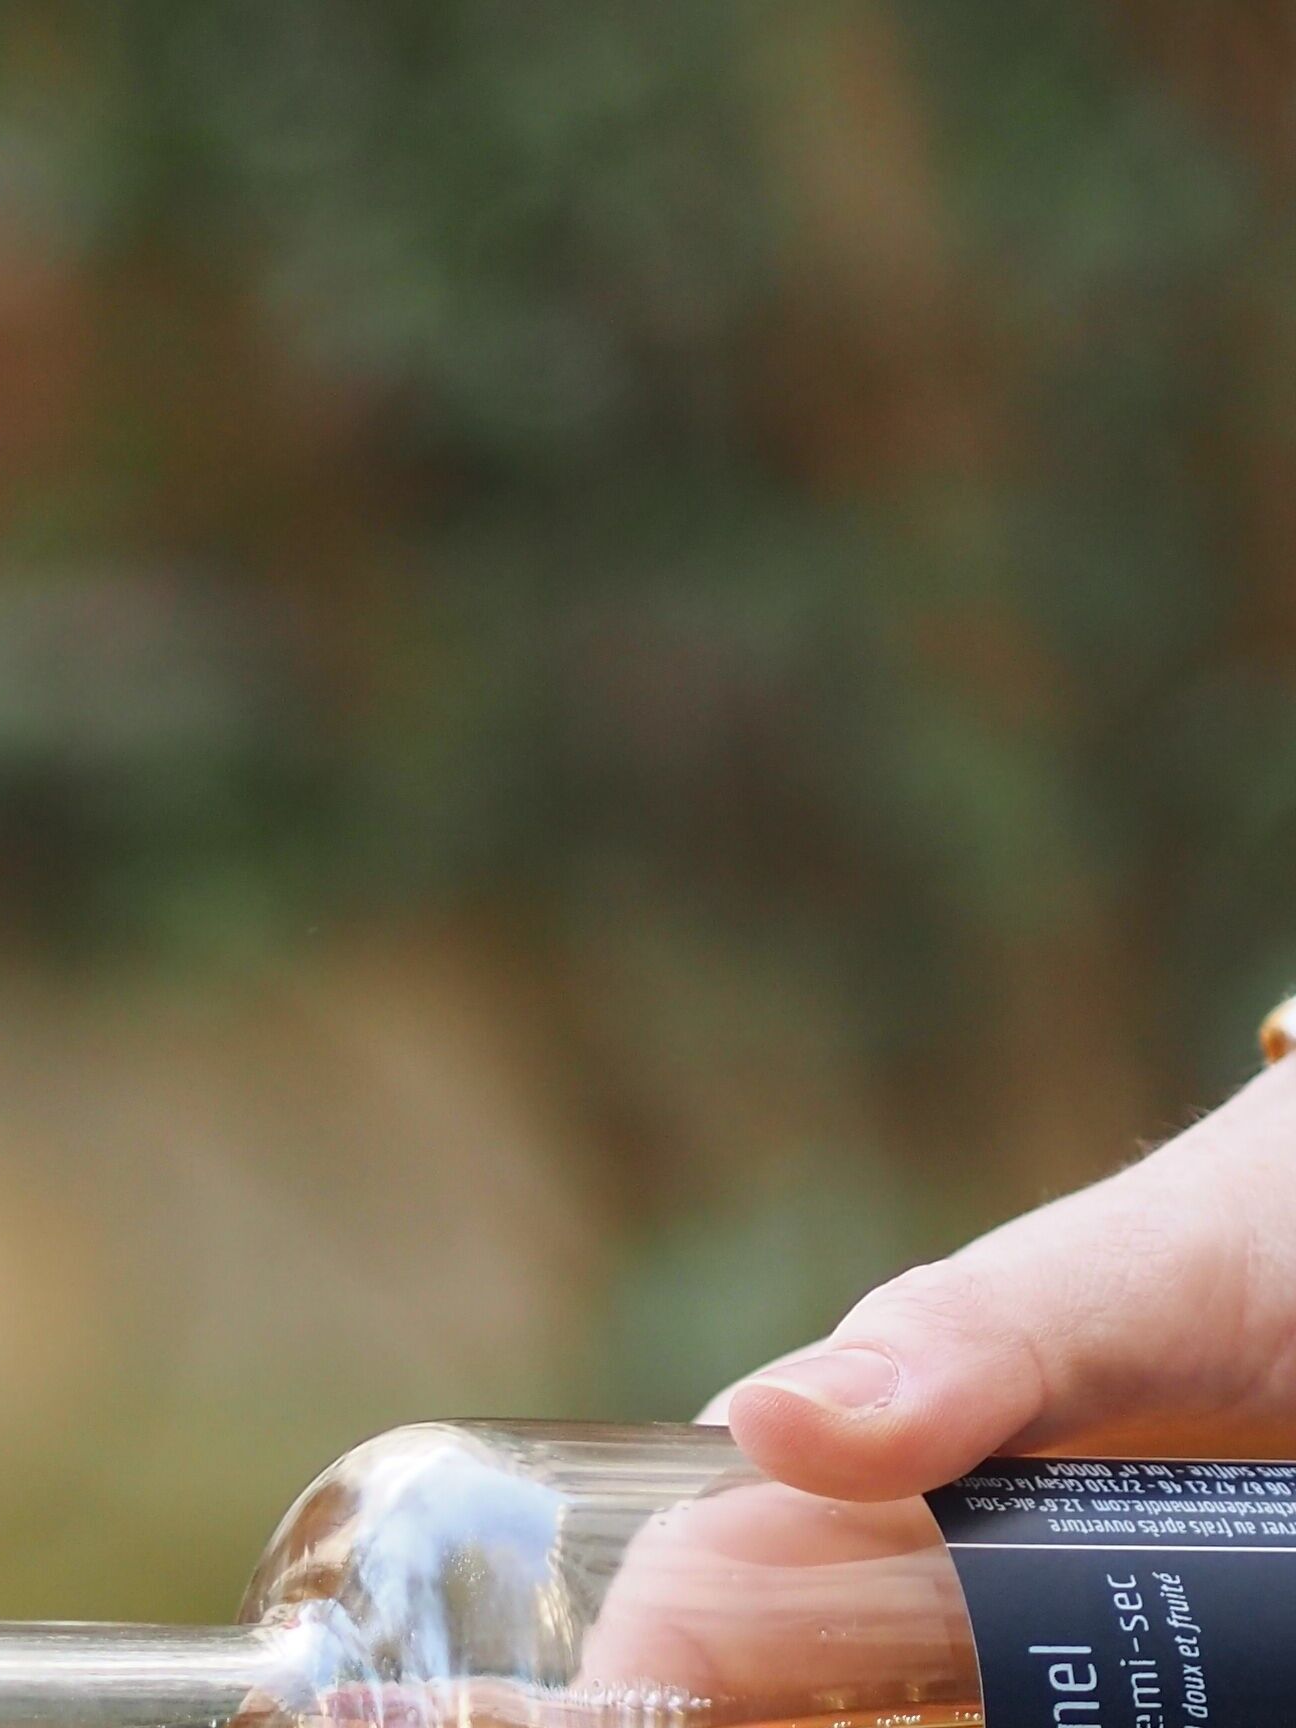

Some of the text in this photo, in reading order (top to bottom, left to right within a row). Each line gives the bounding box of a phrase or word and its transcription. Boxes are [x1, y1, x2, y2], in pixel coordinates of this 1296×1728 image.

[1048, 1518, 1136, 1535] ouverture
[1139, 1516, 1187, 1537] après
[1189, 1517, 1232, 1538] frais
[1233, 1520, 1256, 1537] au
[1151, 1571, 1204, 1633] fruité
[1170, 1635, 1200, 1658] et
[1178, 1664, 1209, 1718] doux
